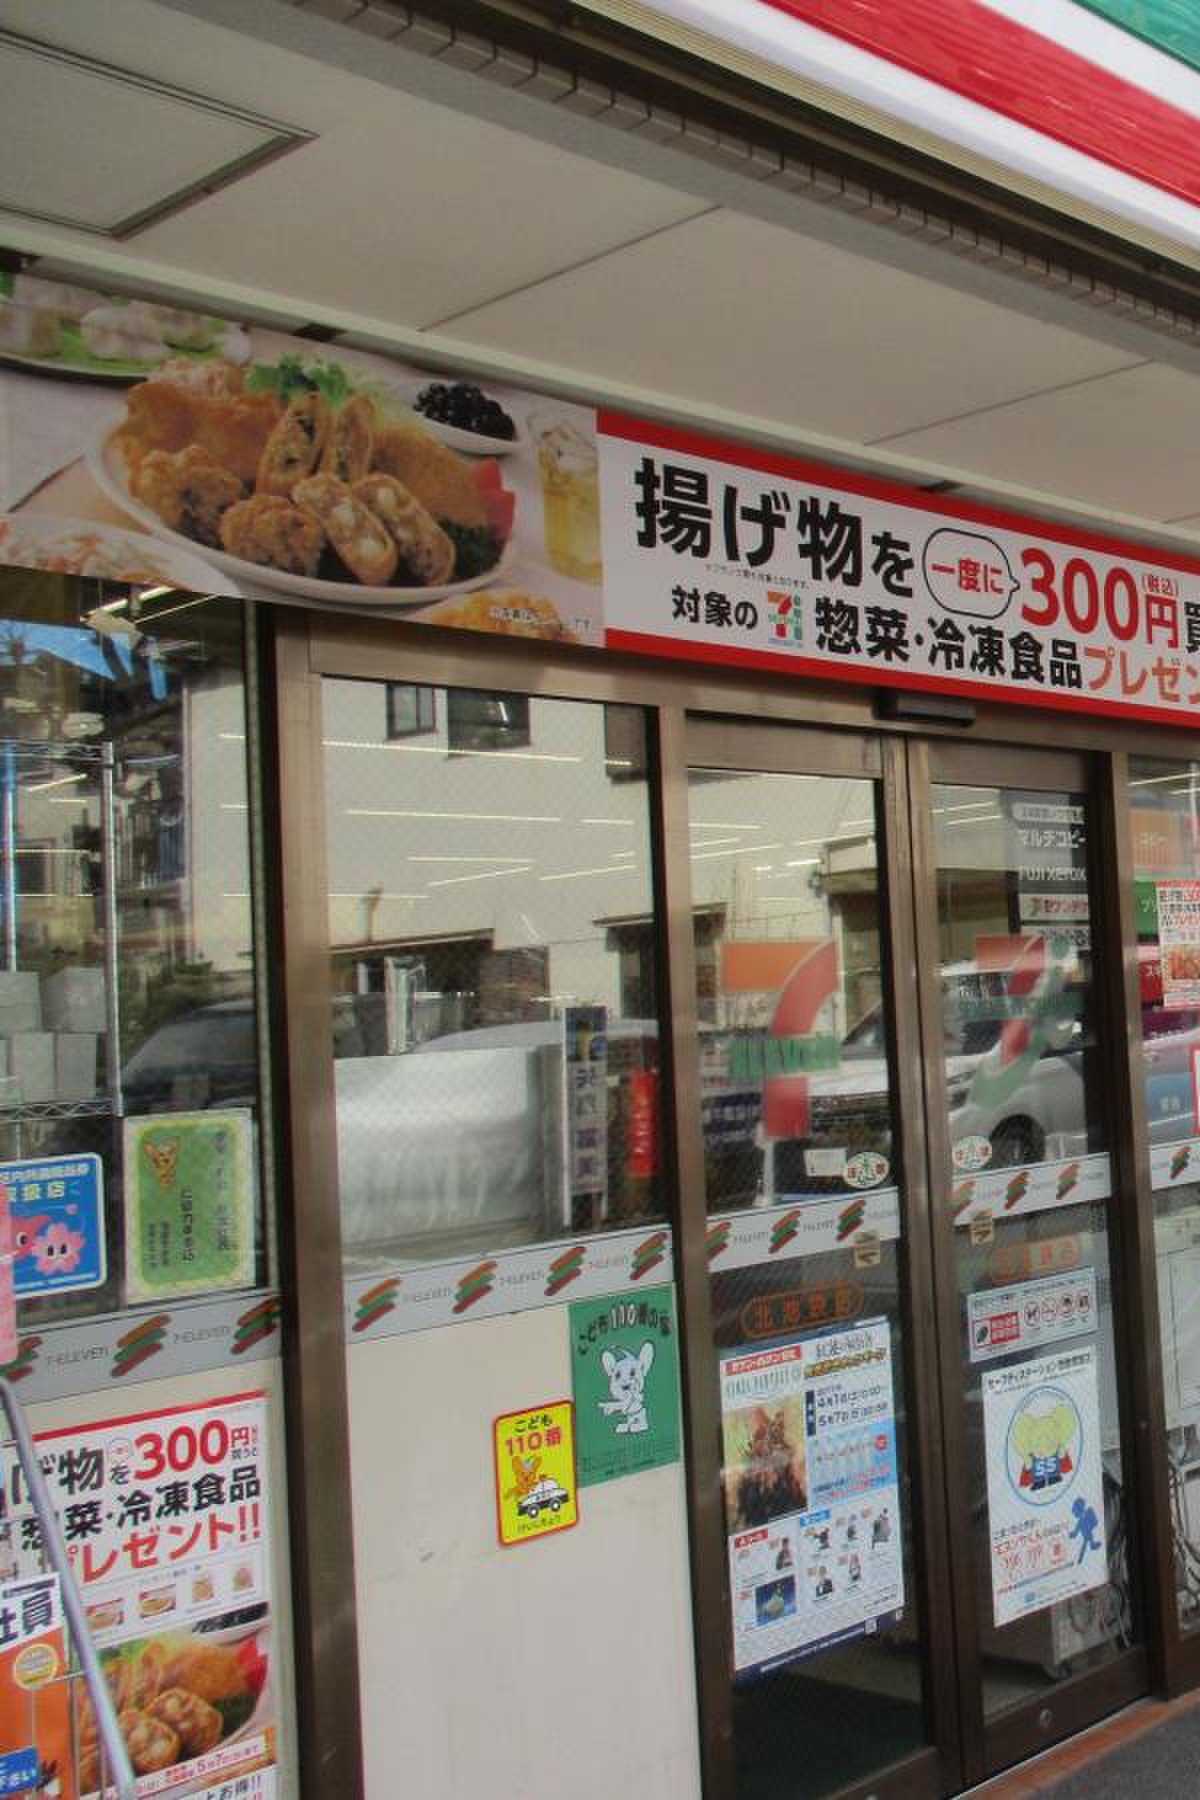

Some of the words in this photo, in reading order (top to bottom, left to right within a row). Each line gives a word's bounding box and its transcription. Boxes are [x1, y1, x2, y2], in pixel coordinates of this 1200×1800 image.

[633, 457, 915, 598] 揚げ物を
[931, 557, 1004, 595] 一度に
[671, 584, 759, 631] 対象の
[505, 1426, 562, 1457] 110番
[515, 1413, 553, 1434] こども
